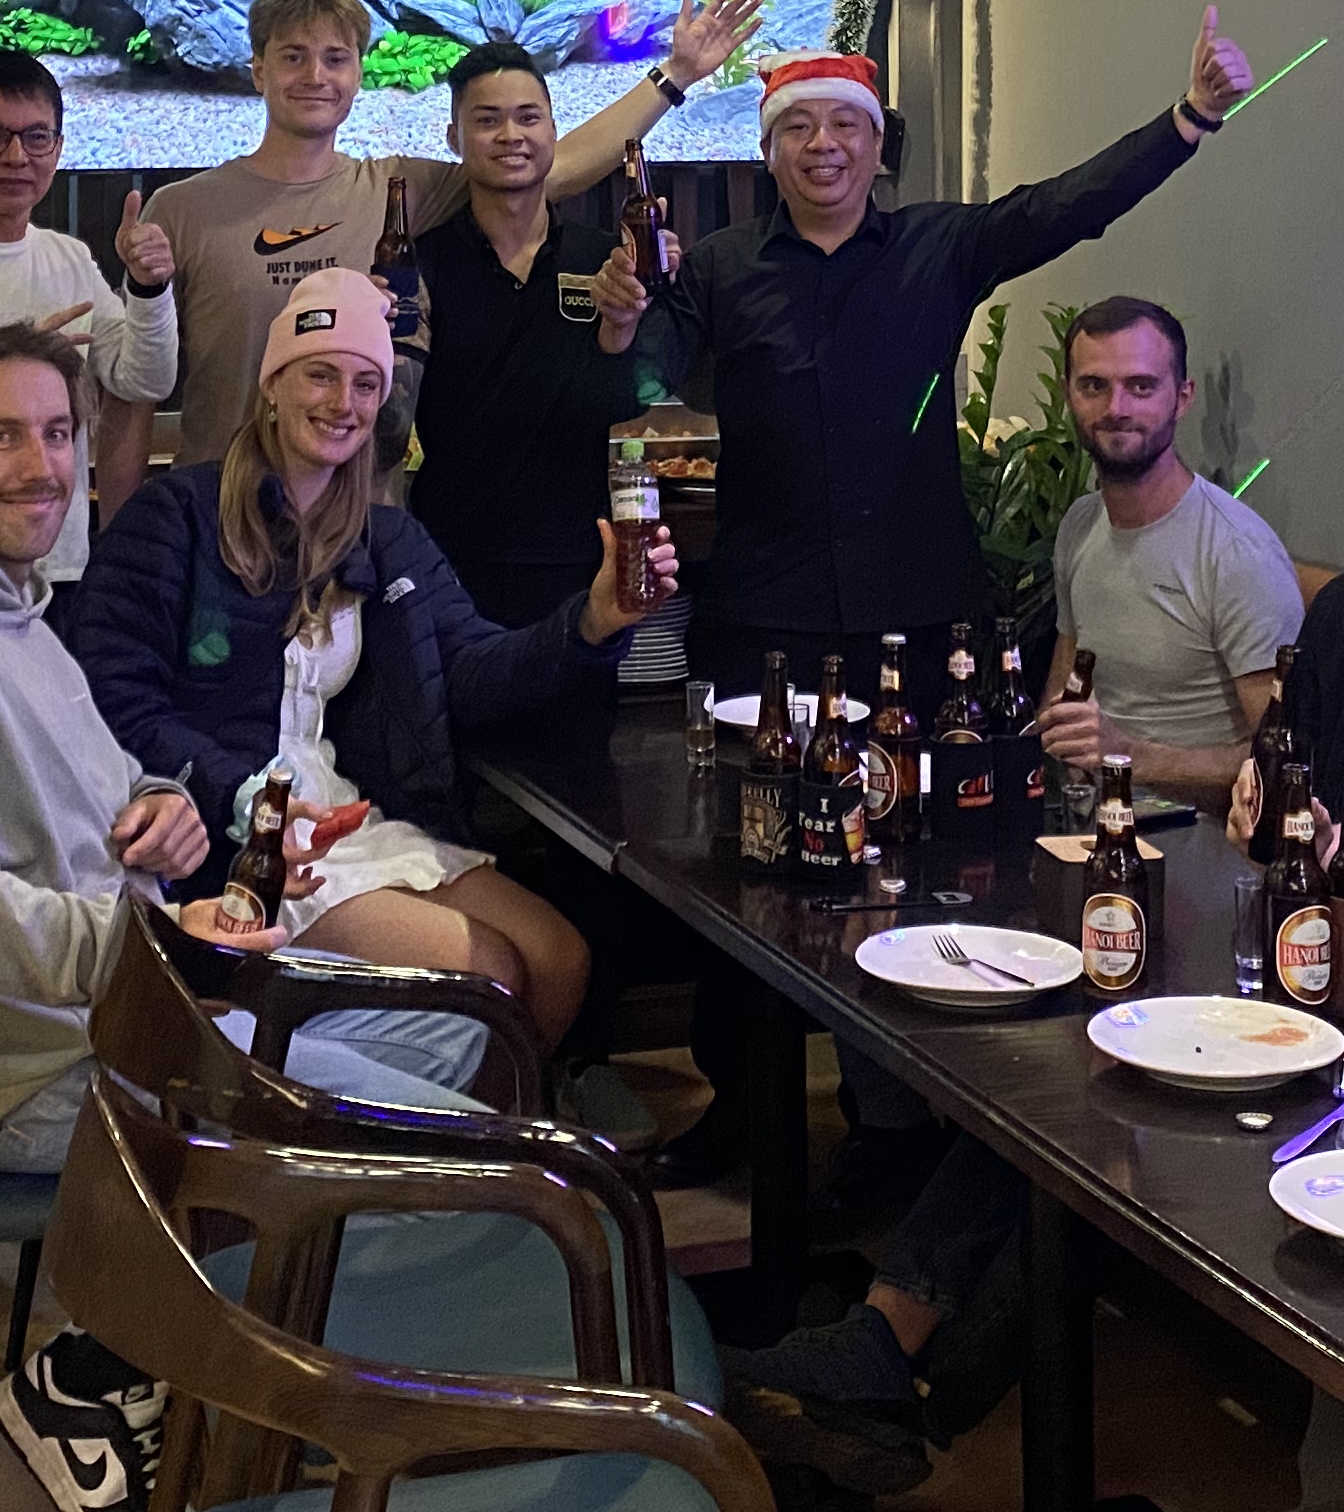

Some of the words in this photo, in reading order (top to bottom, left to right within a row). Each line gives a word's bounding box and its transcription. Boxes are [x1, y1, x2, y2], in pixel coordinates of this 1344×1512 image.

[266, 261, 291, 274] JUST
[294, 258, 323, 273] DUNE
[820, 797, 829, 814] I
[1116, 931, 1141, 950] BEER
[1283, 944, 1319, 966] HANOI
